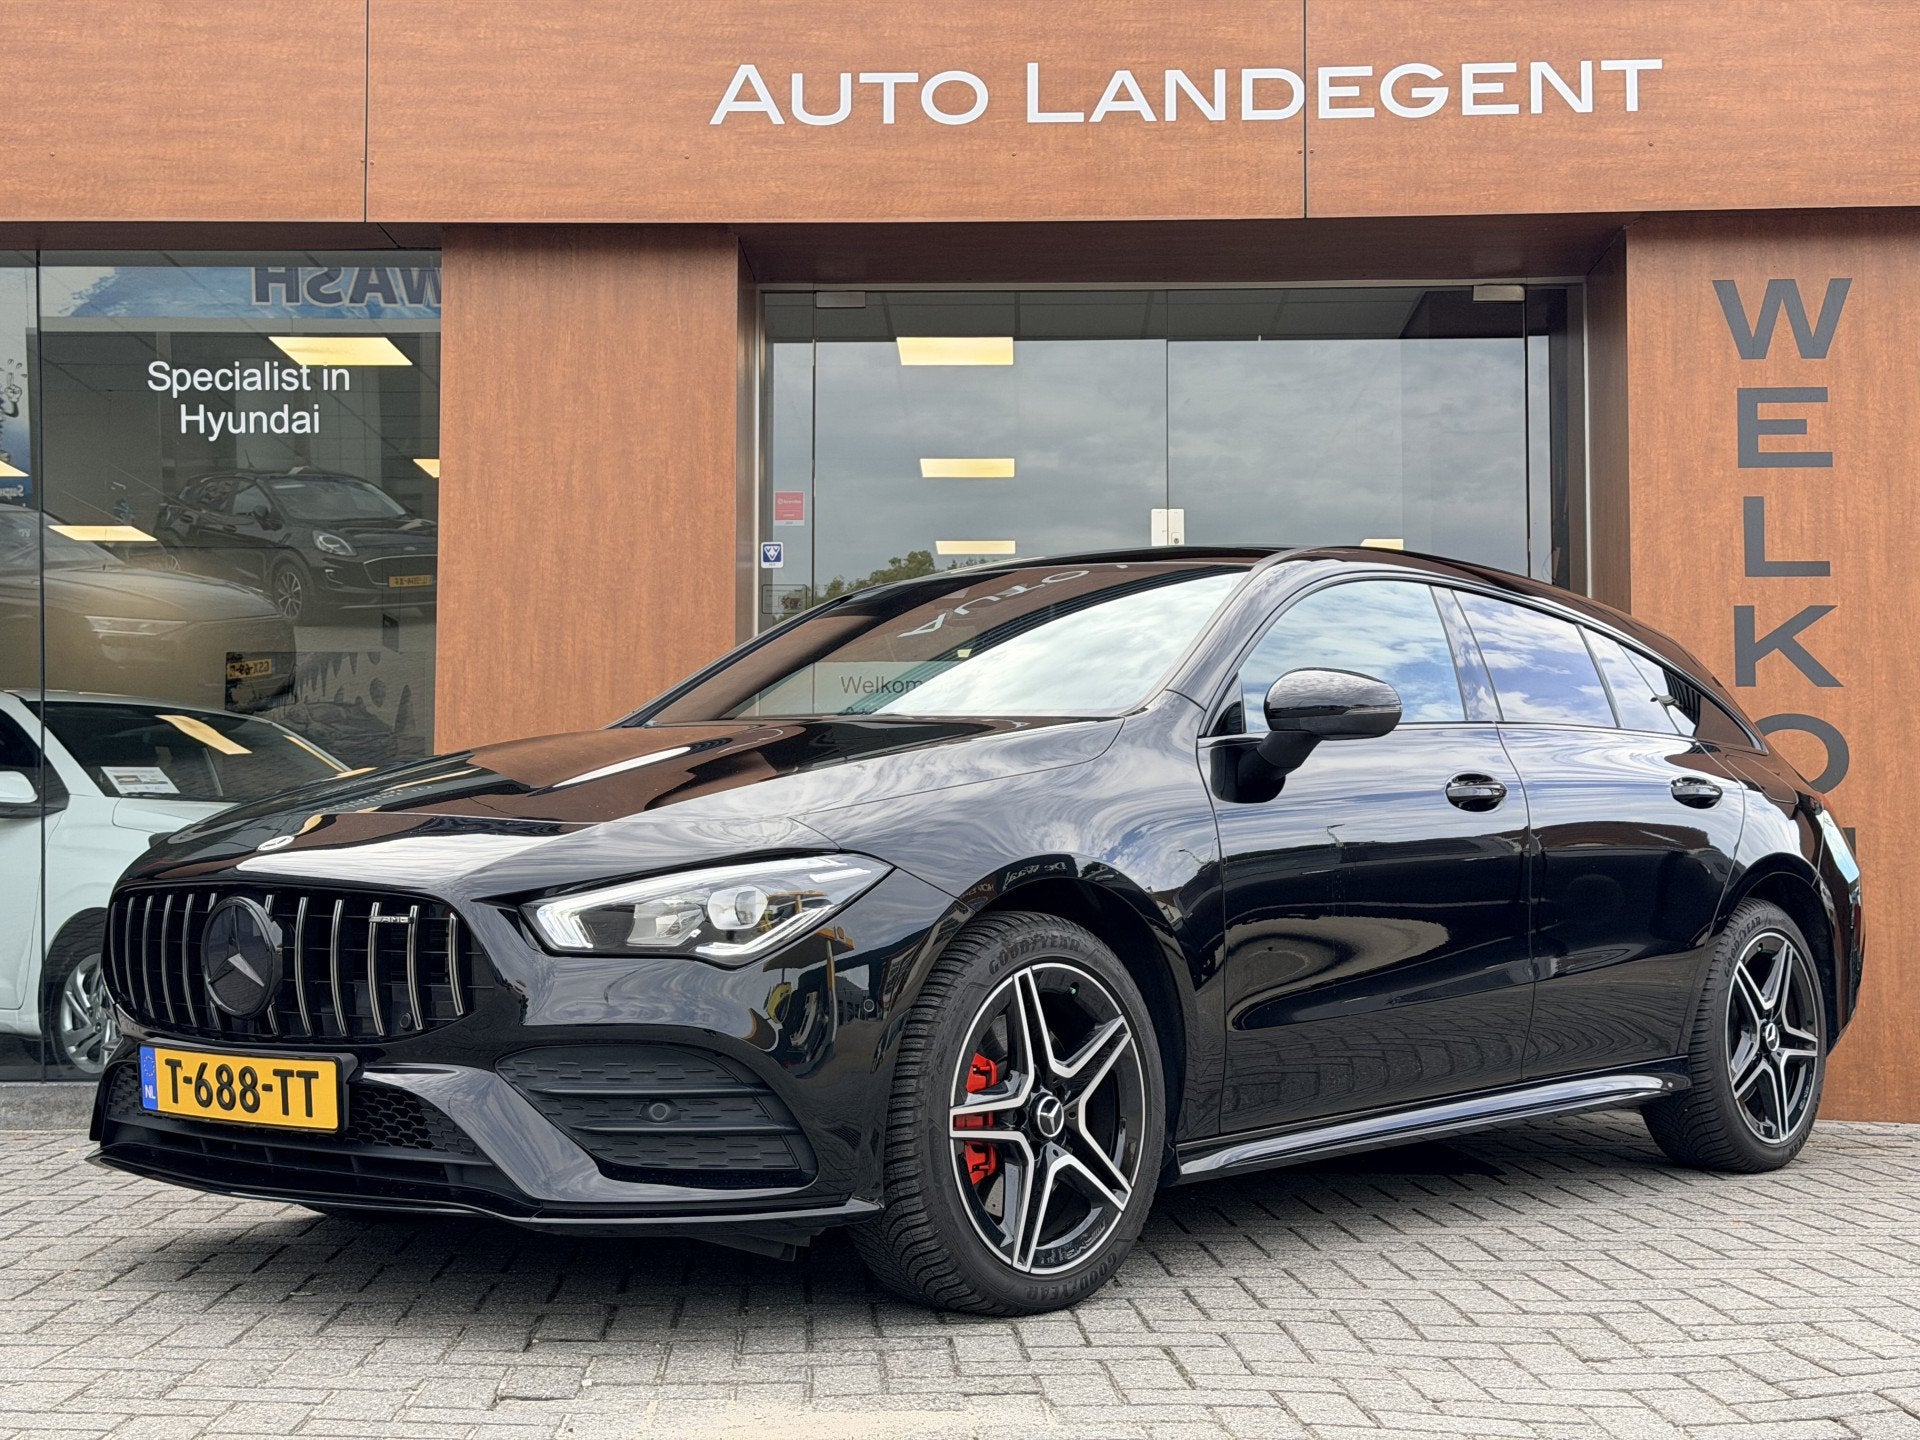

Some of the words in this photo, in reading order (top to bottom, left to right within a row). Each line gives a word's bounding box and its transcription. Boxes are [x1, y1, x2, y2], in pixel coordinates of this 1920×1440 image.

[710, 64, 988, 126] AUTO
[1027, 59, 1662, 123] LANDEGENT
[147, 361, 310, 397] Specialist
[323, 364, 350, 391] in
[180, 404, 320, 441] Hyundai
[1712, 278, 1856, 861] WELKO
[840, 676, 923, 694] Welkom
[145, 1085, 156, 1100] NL
[165, 1058, 319, 1118] T-688-TT
